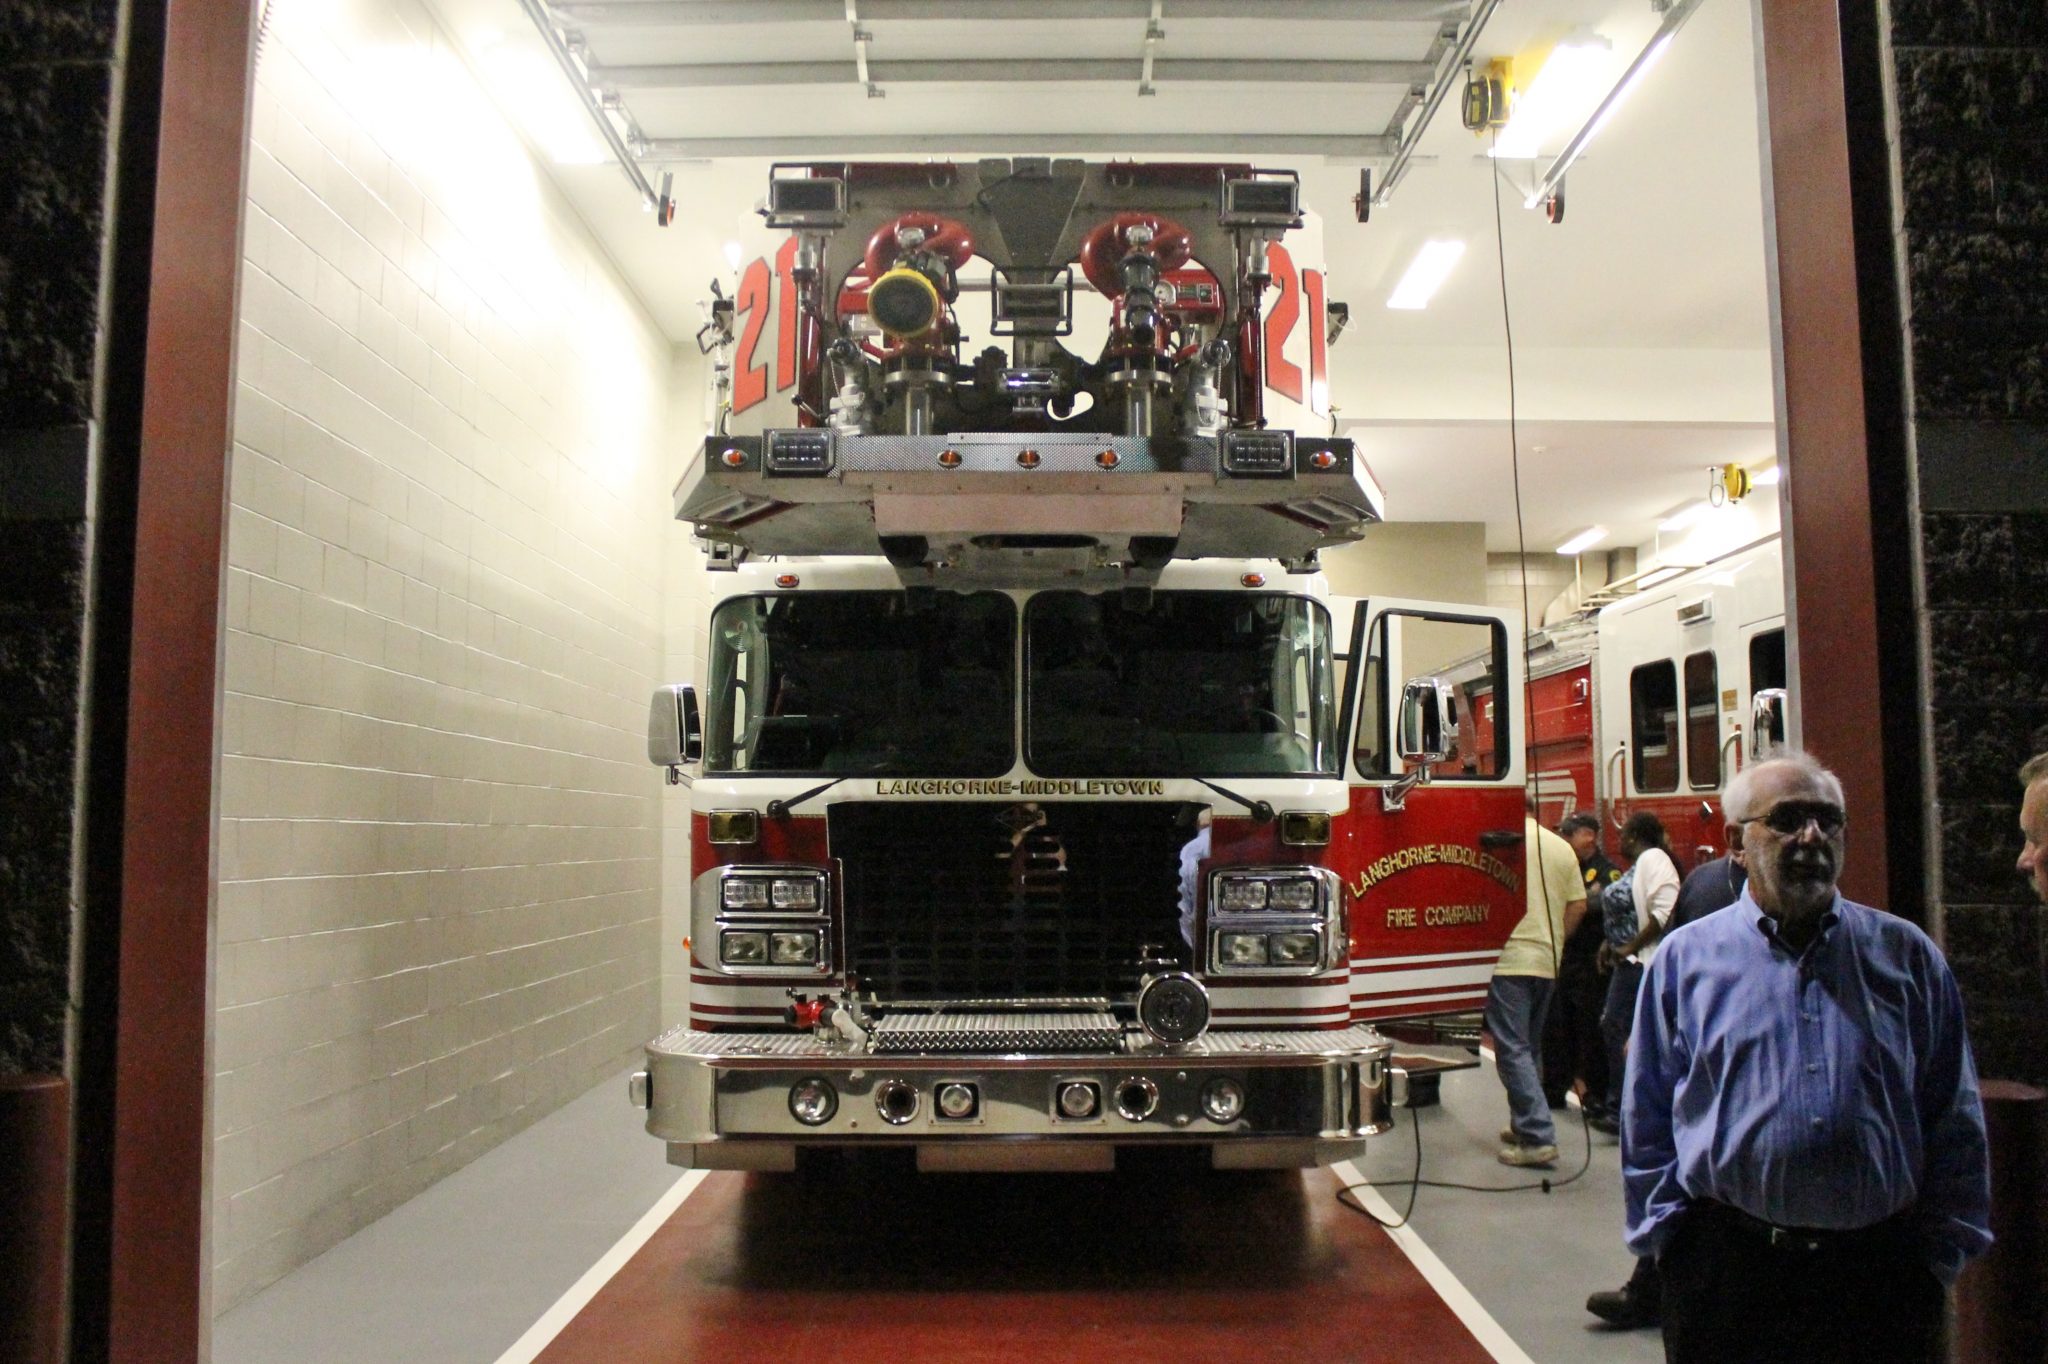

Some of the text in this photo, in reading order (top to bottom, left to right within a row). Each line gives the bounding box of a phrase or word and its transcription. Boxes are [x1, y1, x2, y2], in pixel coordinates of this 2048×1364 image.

[733, 235, 798, 416] 21
[1264, 239, 1327, 420] 21
[876, 779, 1164, 795] LANGHORNE-MIDDLETOWN
[1350, 844, 1521, 898] LANGHORNE-MIDDLETOWN
[1386, 904, 1490, 928] FIRE COMPANY
